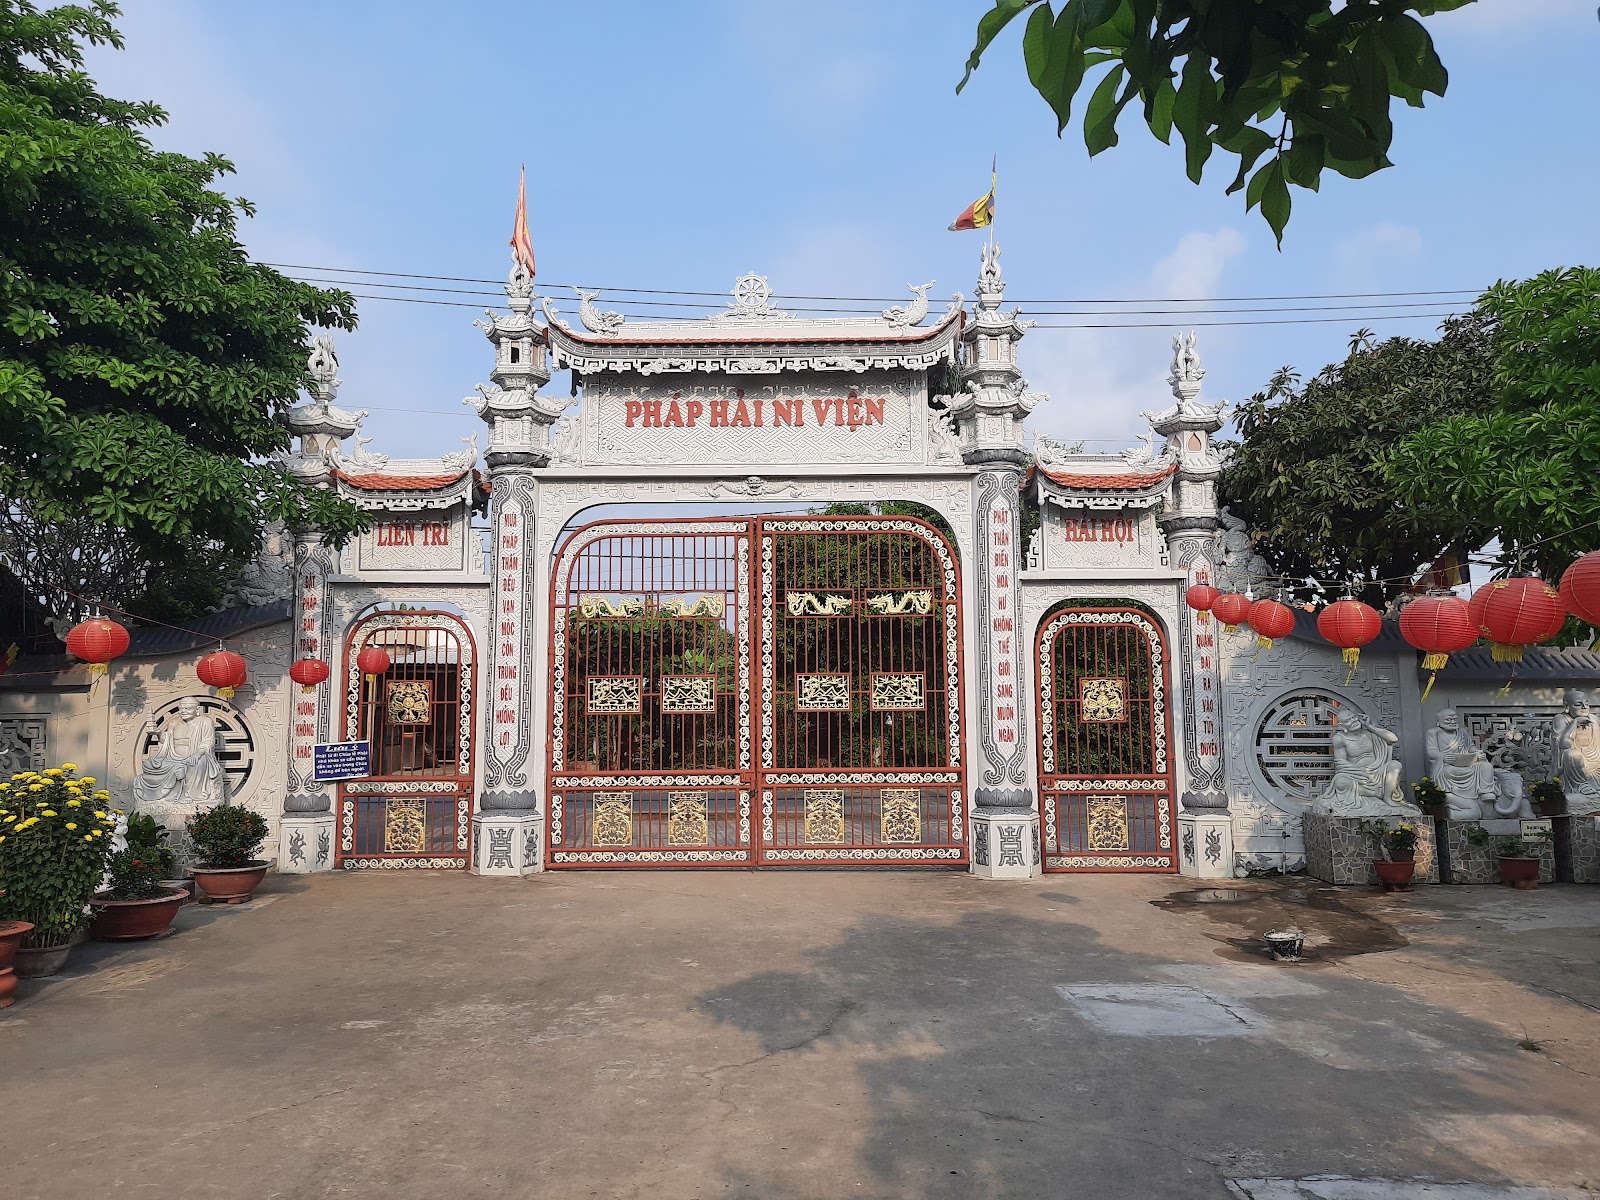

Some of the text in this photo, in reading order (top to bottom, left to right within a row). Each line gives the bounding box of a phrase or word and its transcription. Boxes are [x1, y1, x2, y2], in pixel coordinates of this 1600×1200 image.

[624, 388, 886, 432] PHÁP HẢI NI VIỆN
[376, 517, 417, 547] LIÊN
[502, 532, 519, 549] PHÁP
[1064, 511, 1134, 549] HẢI HỘI
